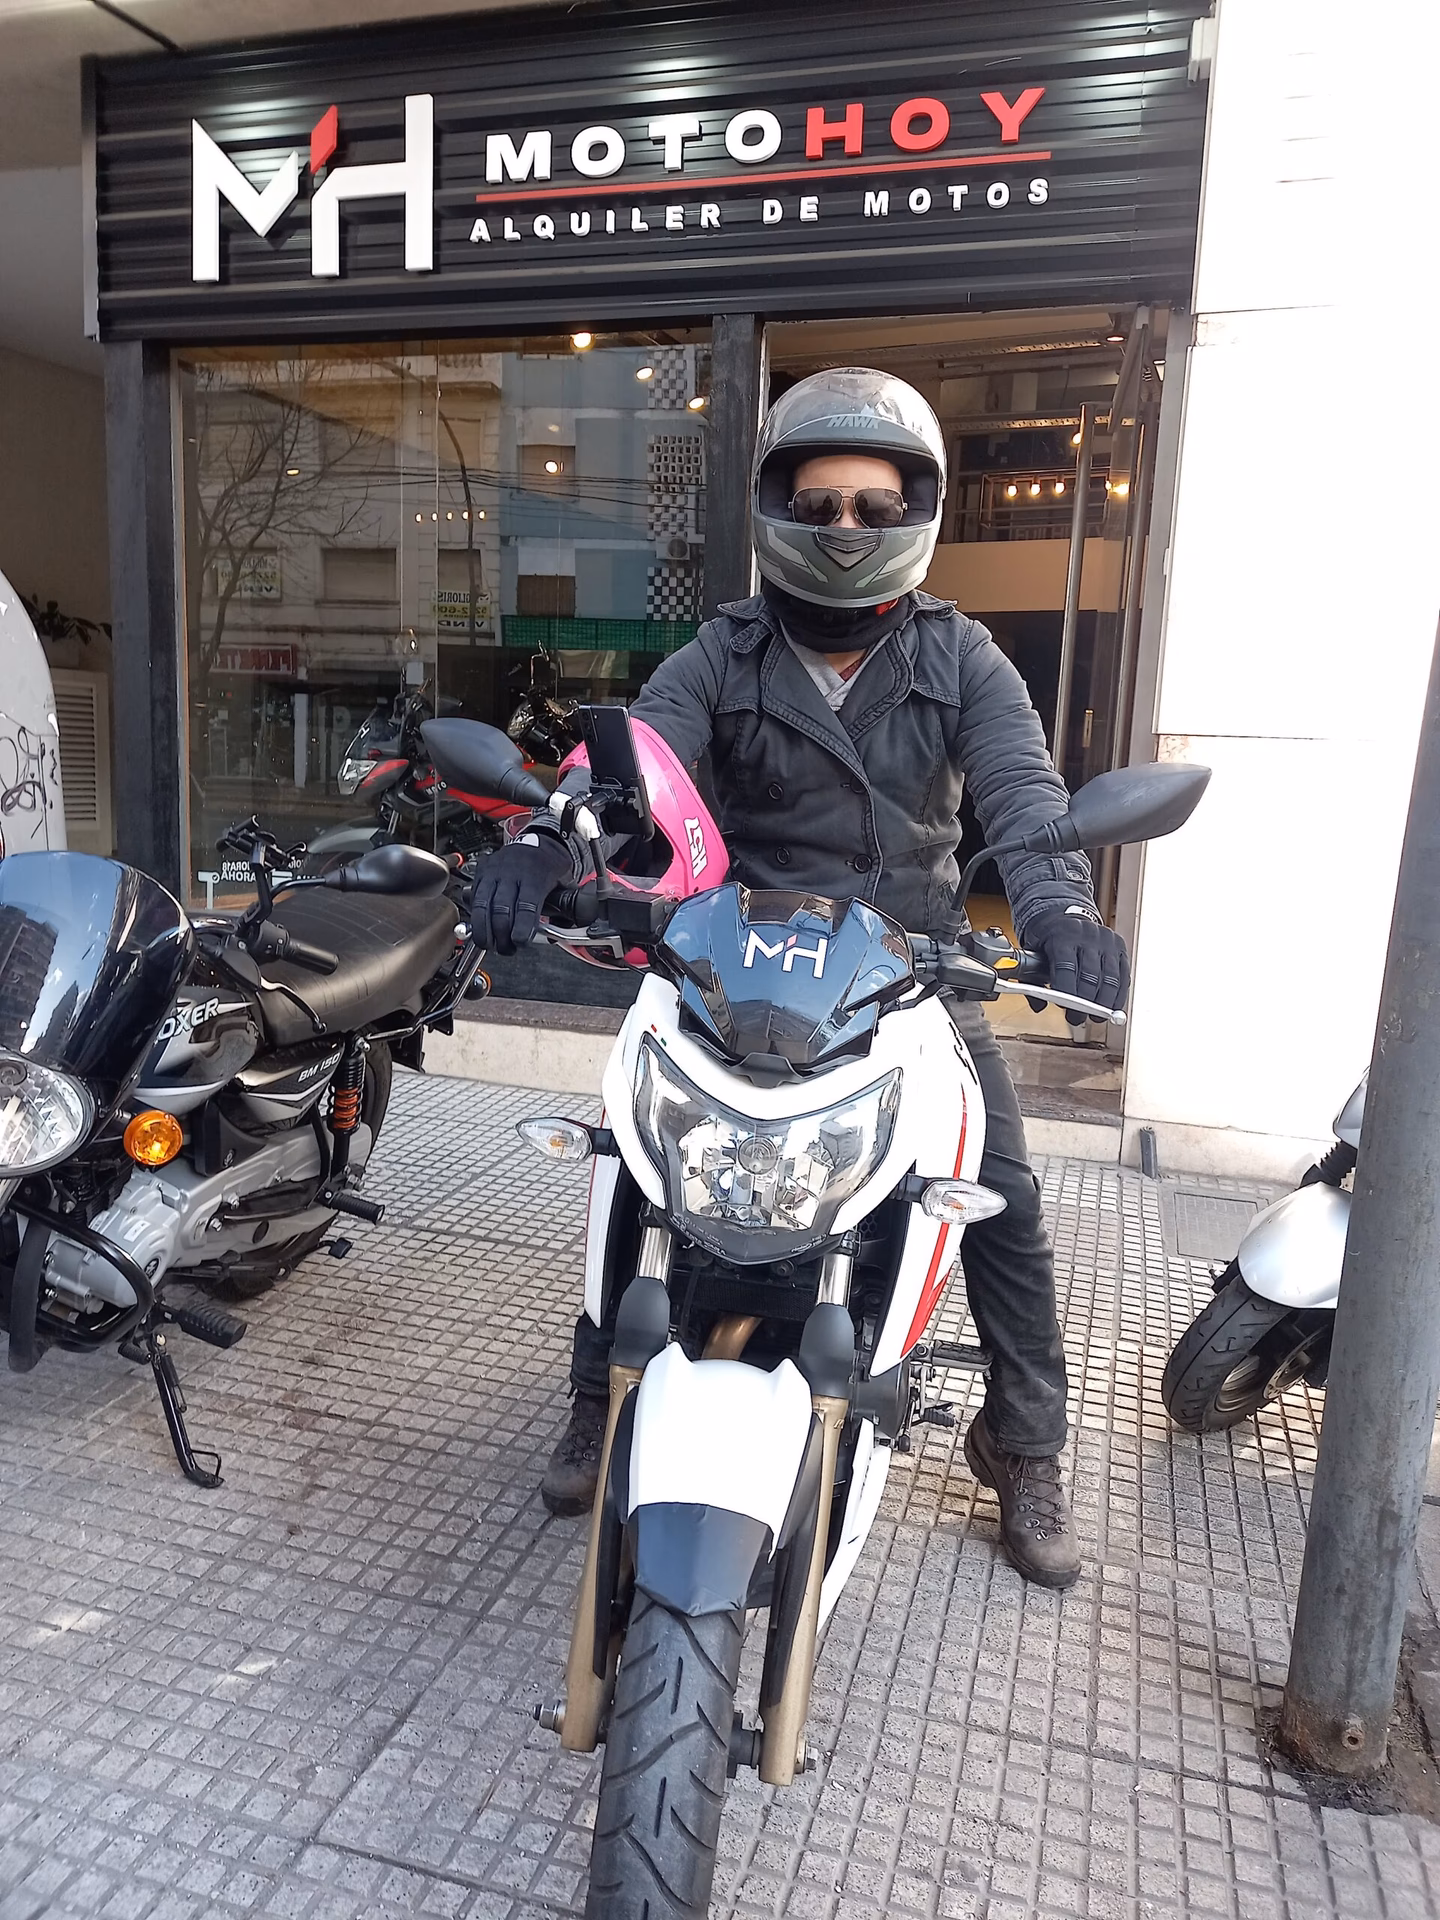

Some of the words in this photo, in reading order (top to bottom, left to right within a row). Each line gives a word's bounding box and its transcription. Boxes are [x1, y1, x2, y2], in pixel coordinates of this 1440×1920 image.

[469, 202, 722, 243] ALQUILER
[762, 195, 820, 224] DE
[863, 177, 1050, 217] MOTOS
[826, 415, 880, 430] HAWK
[157, 997, 219, 1042] OXER
[298, 1063, 319, 1083] BM
[319, 1052, 341, 1072] 150
